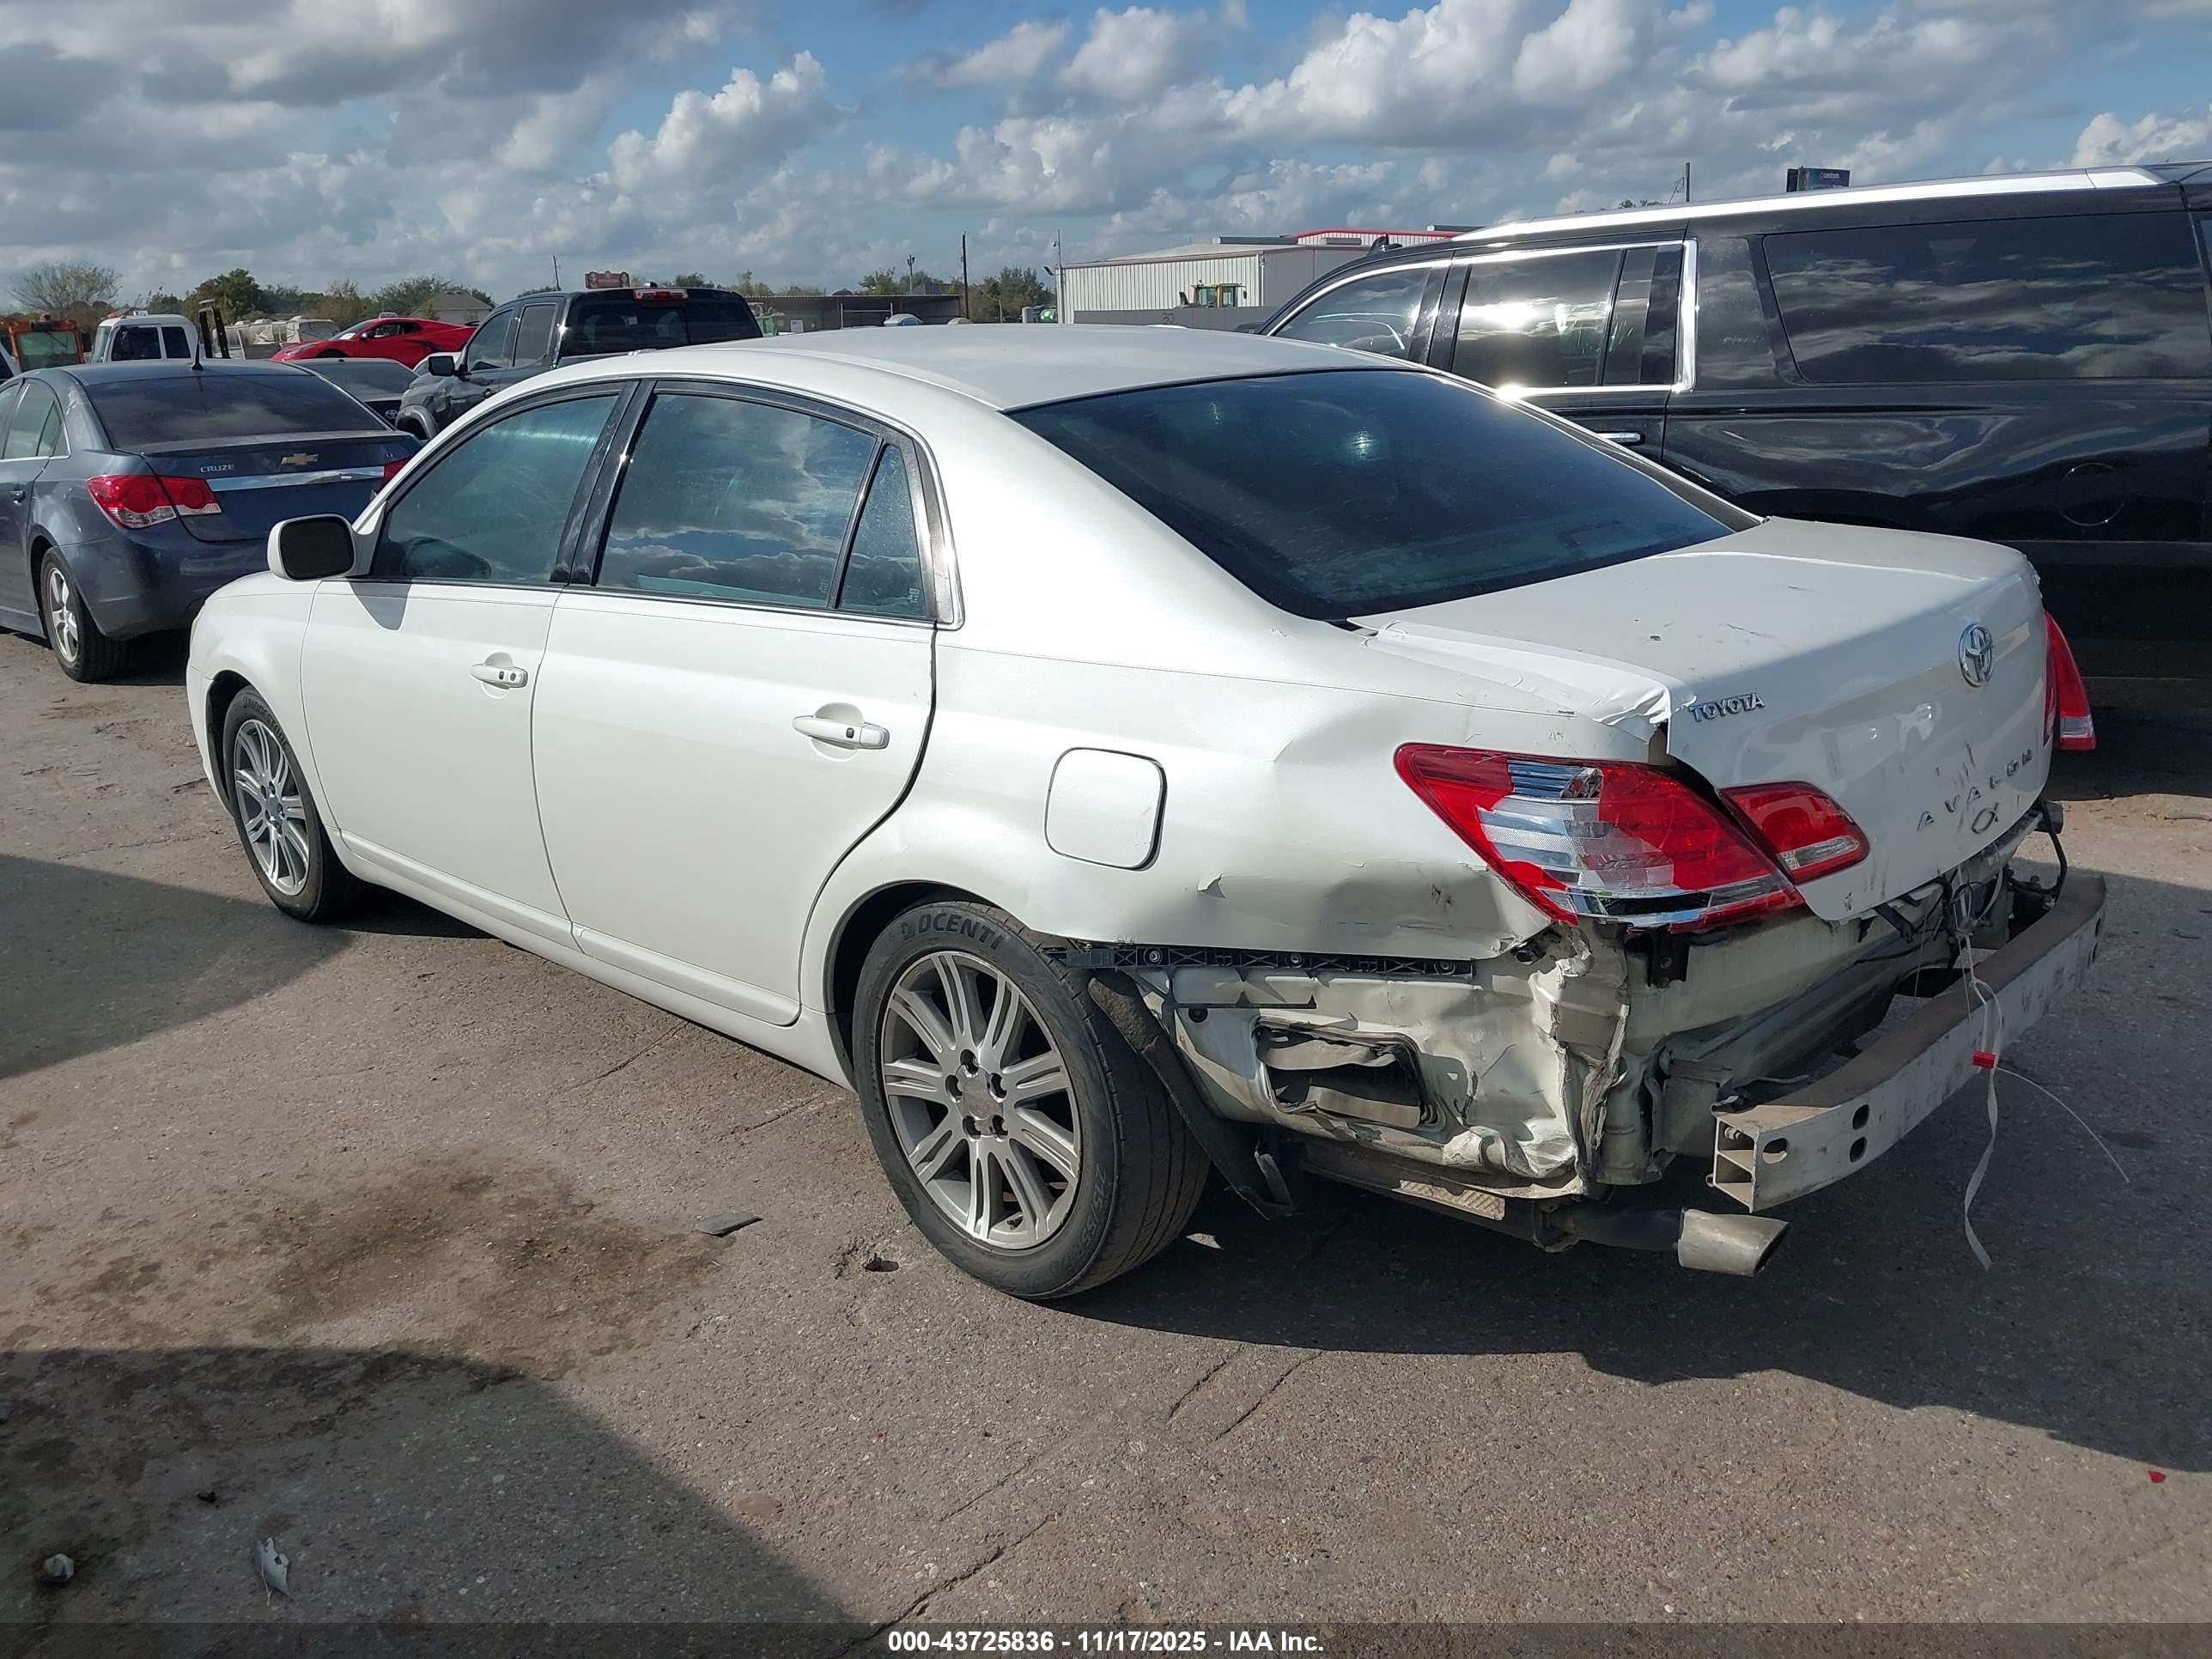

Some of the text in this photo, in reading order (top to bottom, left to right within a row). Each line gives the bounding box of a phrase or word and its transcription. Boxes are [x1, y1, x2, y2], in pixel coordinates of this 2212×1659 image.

[200, 464, 234, 473] CRUZE
[1688, 692, 1765, 722] TOYOTA
[1917, 749, 2033, 831] AVALON
